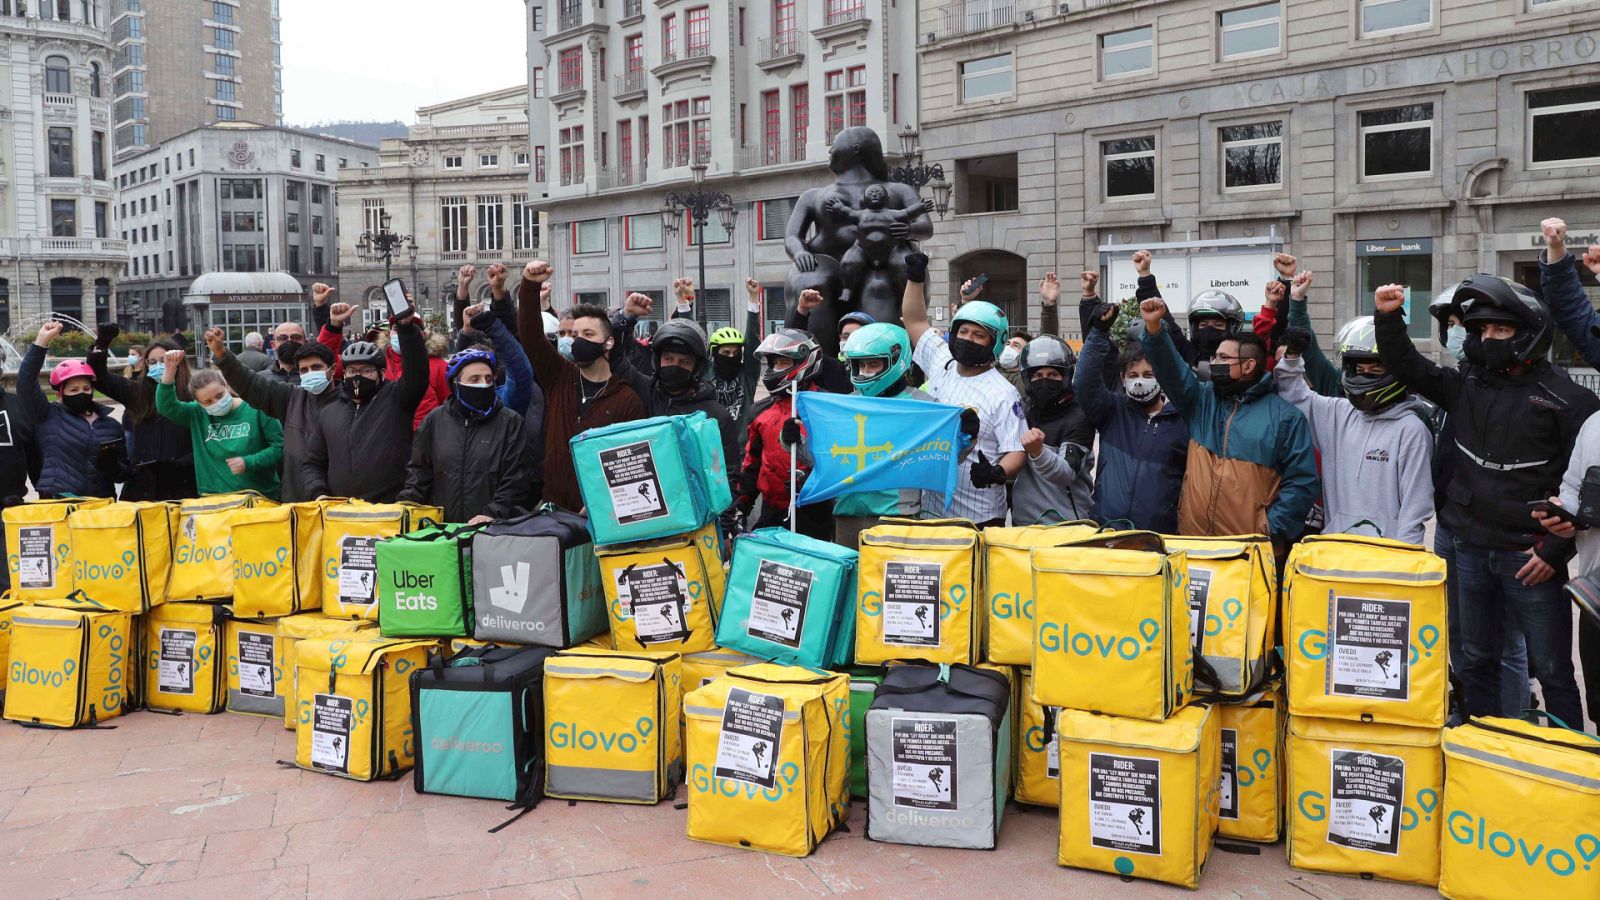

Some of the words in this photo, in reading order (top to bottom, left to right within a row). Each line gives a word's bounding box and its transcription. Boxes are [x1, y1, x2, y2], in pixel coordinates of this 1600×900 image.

[1248, 76, 1330, 103] CAJA
[1363, 66, 1399, 88] DE
[1210, 279, 1249, 288] Liberbank
[176, 544, 227, 565] Glovo
[75, 560, 124, 580] Glovo
[231, 558, 278, 580] Glovo
[393, 570, 436, 589] Uber
[395, 591, 438, 611] Eats
[1362, 603, 1385, 613] RIDER:
[482, 612, 546, 631] deliveroo
[1039, 621, 1141, 661] Glovo
[11, 660, 64, 688] Glovo
[102, 634, 123, 712] Glovo
[430, 735, 504, 754] deliveroo
[550, 720, 638, 754] Glovo
[1114, 760, 1135, 770] RIDER:
[885, 808, 974, 829] deliveroo
[1447, 810, 1576, 877] Glovo
